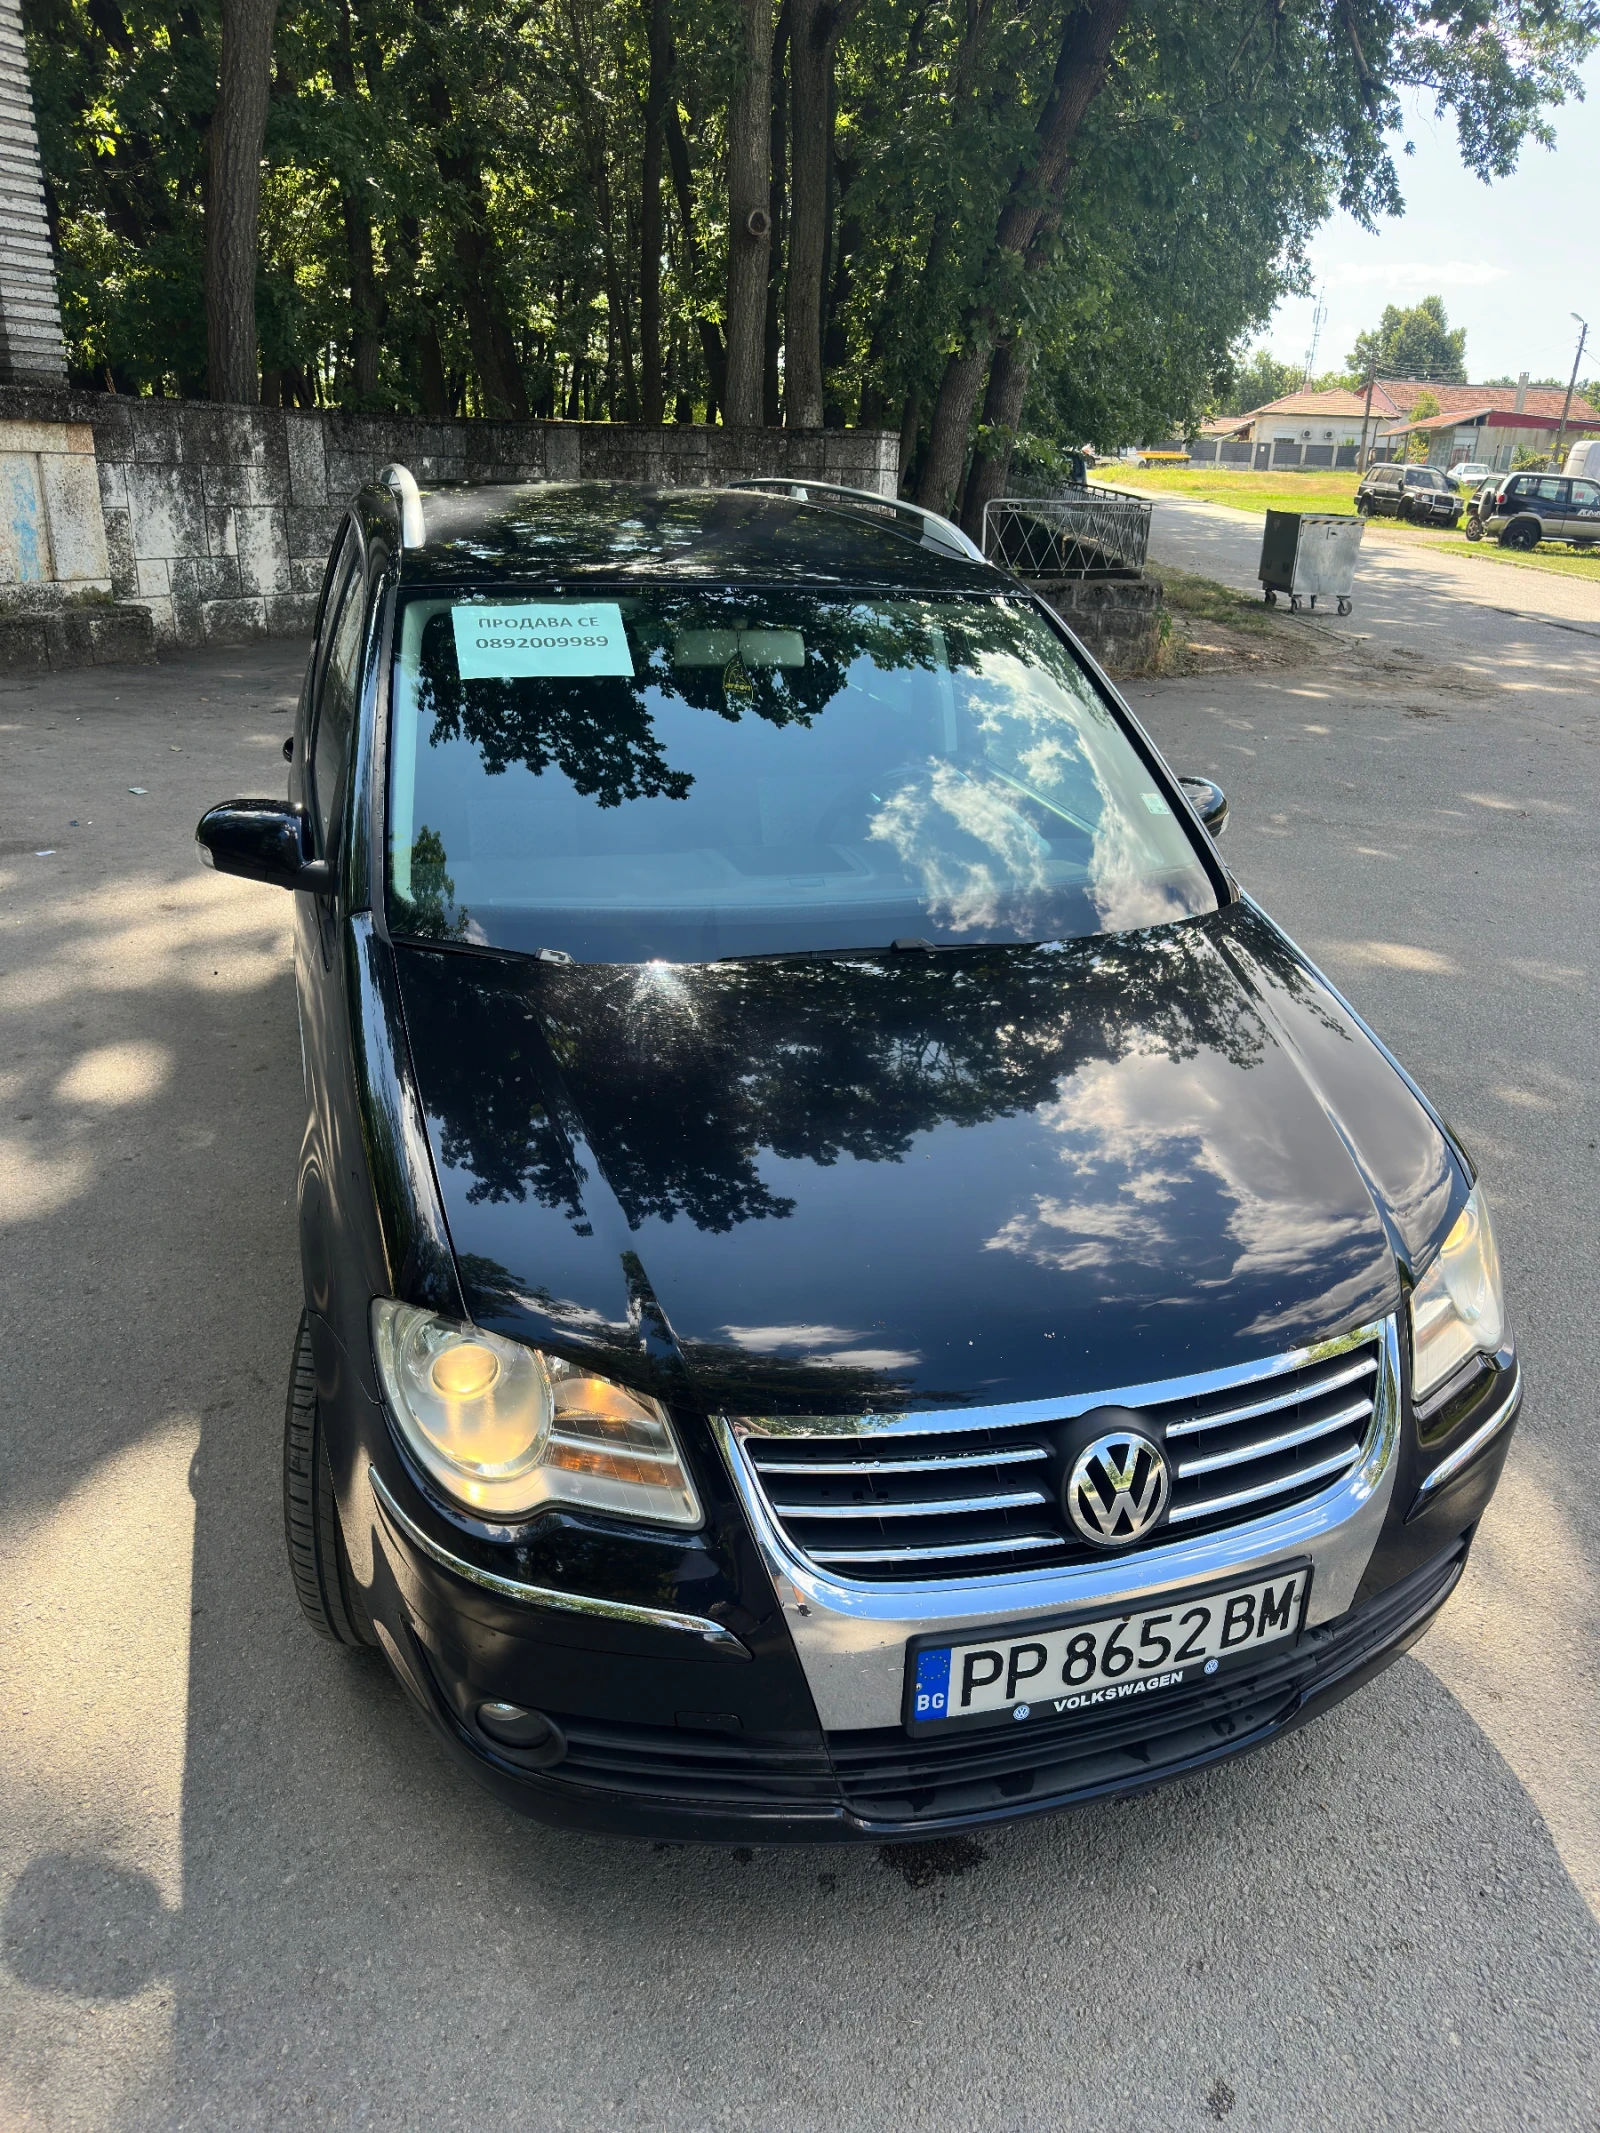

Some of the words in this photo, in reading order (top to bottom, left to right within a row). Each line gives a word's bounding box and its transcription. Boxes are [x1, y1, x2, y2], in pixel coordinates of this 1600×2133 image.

[478, 617, 573, 630] ПРОДАВА
[577, 616, 600, 627] СЕ
[475, 636, 609, 649] 0892009989
[960, 1642, 1048, 1707] PP
[1061, 1606, 1212, 1686] 8652
[1219, 1579, 1297, 1650] BM
[1053, 1670, 1184, 1713] VOLKSWAGEN
[917, 1692, 945, 1711] BG
